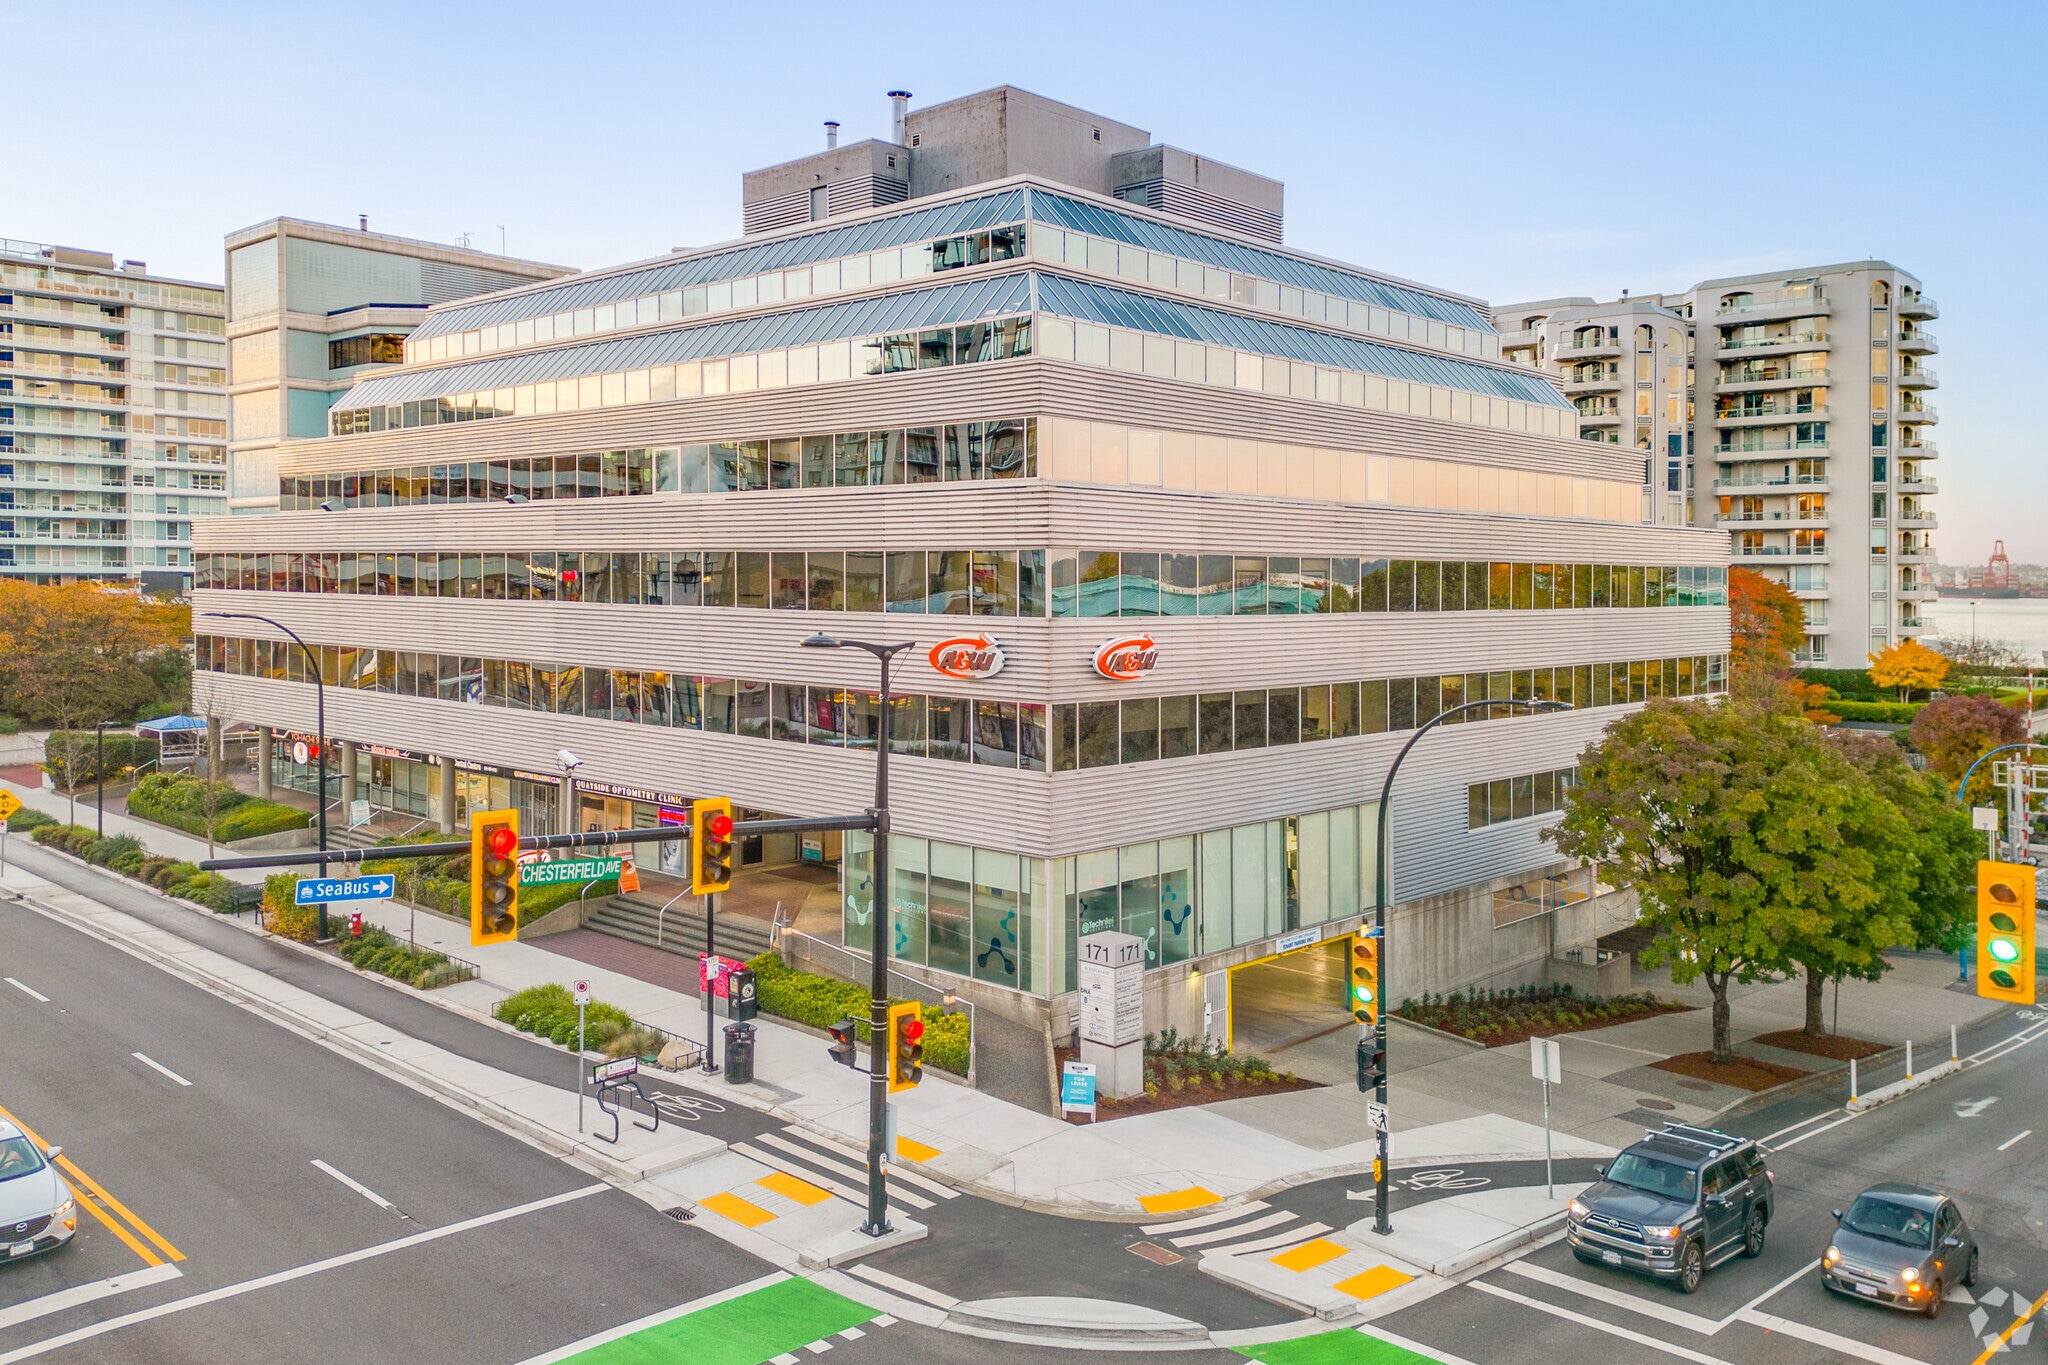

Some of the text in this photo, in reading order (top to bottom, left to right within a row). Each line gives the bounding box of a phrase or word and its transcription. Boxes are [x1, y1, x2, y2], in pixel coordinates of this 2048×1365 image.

[937, 650, 997, 671] A&W
[1109, 651, 1160, 672] A&W
[315, 736, 330, 747] SHI
[575, 780, 683, 805] QUAYSIDE OPTOMETRY CLINIC
[521, 861, 605, 883] CHESTERFIELD
[605, 860, 621, 873] AVE
[316, 881, 369, 897] SeaBus
[1085, 943, 1108, 963] 171
[1120, 943, 1139, 962] 171
